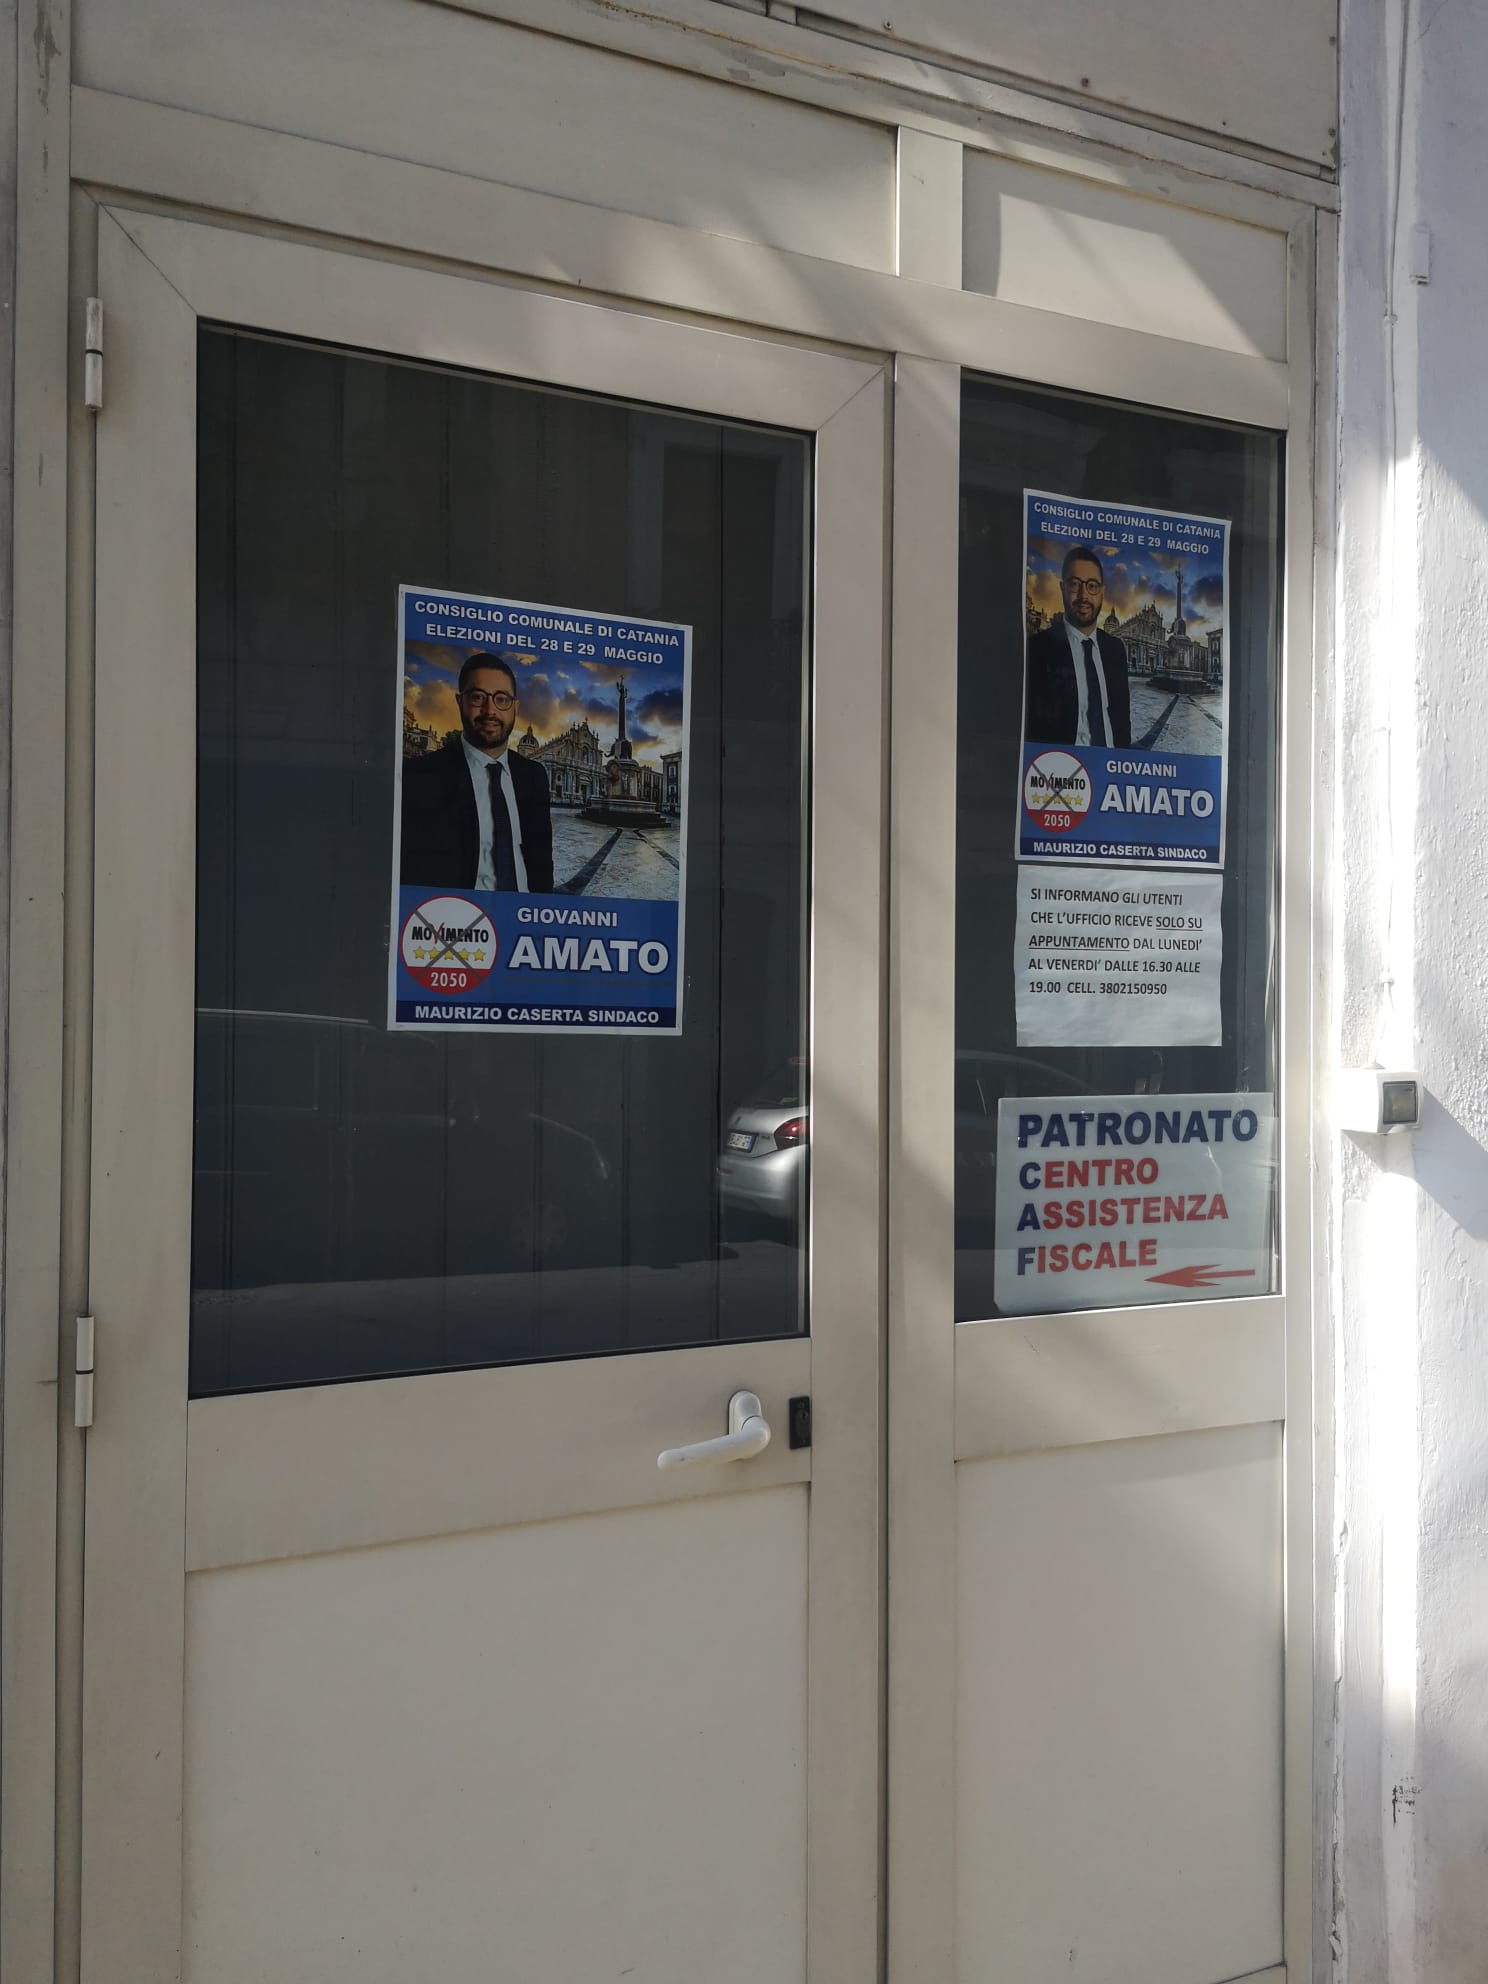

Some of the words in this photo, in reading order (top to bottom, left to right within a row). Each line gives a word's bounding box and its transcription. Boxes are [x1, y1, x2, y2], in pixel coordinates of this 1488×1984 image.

[1034, 502, 1093, 521] CONSIGLIO
[1098, 513, 1159, 529] COMUNALE
[1163, 522, 1172, 531] DI
[1176, 524, 1220, 539] CATANIA
[1041, 522, 1091, 539] ELEZIONI
[1096, 530, 1117, 541] DEL
[1122, 534, 1133, 544] 28
[1138, 536, 1144, 545] E
[1148, 537, 1160, 547] 29
[1167, 539, 1209, 554] MAGGIO
[415, 601, 503, 622] CONSIGLIO
[509, 613, 592, 635] COMUNALE
[598, 625, 611, 637] DI
[617, 628, 678, 646] CATANIA
[426, 623, 500, 643] ELEZIONI
[507, 634, 535, 648] DEL
[541, 638, 558, 650] 28
[564, 641, 572, 652] E
[578, 643, 595, 655] 29
[605, 646, 663, 664] MAGGIO
[1107, 760, 1176, 777] GIOVANNI
[1031, 772, 1085, 791] MOVIMENTO
[1100, 784, 1214, 818] AMATO
[1044, 815, 1070, 827] 2050
[1034, 842, 1096, 854] MAURIZIO
[1100, 844, 1154, 857] CASERTA
[1158, 847, 1207, 859] SINDACO
[1031, 888, 1040, 900] SI
[1045, 889, 1119, 903] INFORMANO
[1123, 893, 1139, 904] GLI
[1144, 893, 1182, 905] UTENTI
[517, 907, 617, 927] GIOVANNI
[1031, 912, 1053, 924] CHE
[1115, 915, 1153, 927] RICEVE
[1156, 916, 1184, 928] SOLO
[1188, 917, 1202, 928] SU
[412, 923, 489, 944] MOVIMENTO
[1029, 935, 1130, 948] APPUNTAMENTO
[1133, 938, 1155, 949] DAL
[508, 936, 669, 974] AMATO
[1029, 958, 1043, 970] AL
[1105, 960, 1139, 972] DALLE
[1143, 961, 1172, 972] 16.30
[1175, 962, 1200, 973] ALLE
[431, 972, 466, 988] 2050
[1029, 982, 1060, 993] 19.00
[1067, 982, 1095, 994] CELL.
[1100, 983, 1167, 994] 3802150950
[416, 1005, 501, 1020] MAURIZIO
[507, 1008, 583, 1022] CASERTA
[589, 1010, 659, 1024] SINDACO
[1018, 1110, 1258, 1148] PATRONATO
[1020, 1158, 1159, 1190] CENTRO
[1017, 1194, 1229, 1231] ASSISTENZA
[1017, 1239, 1157, 1275] FISCALE
